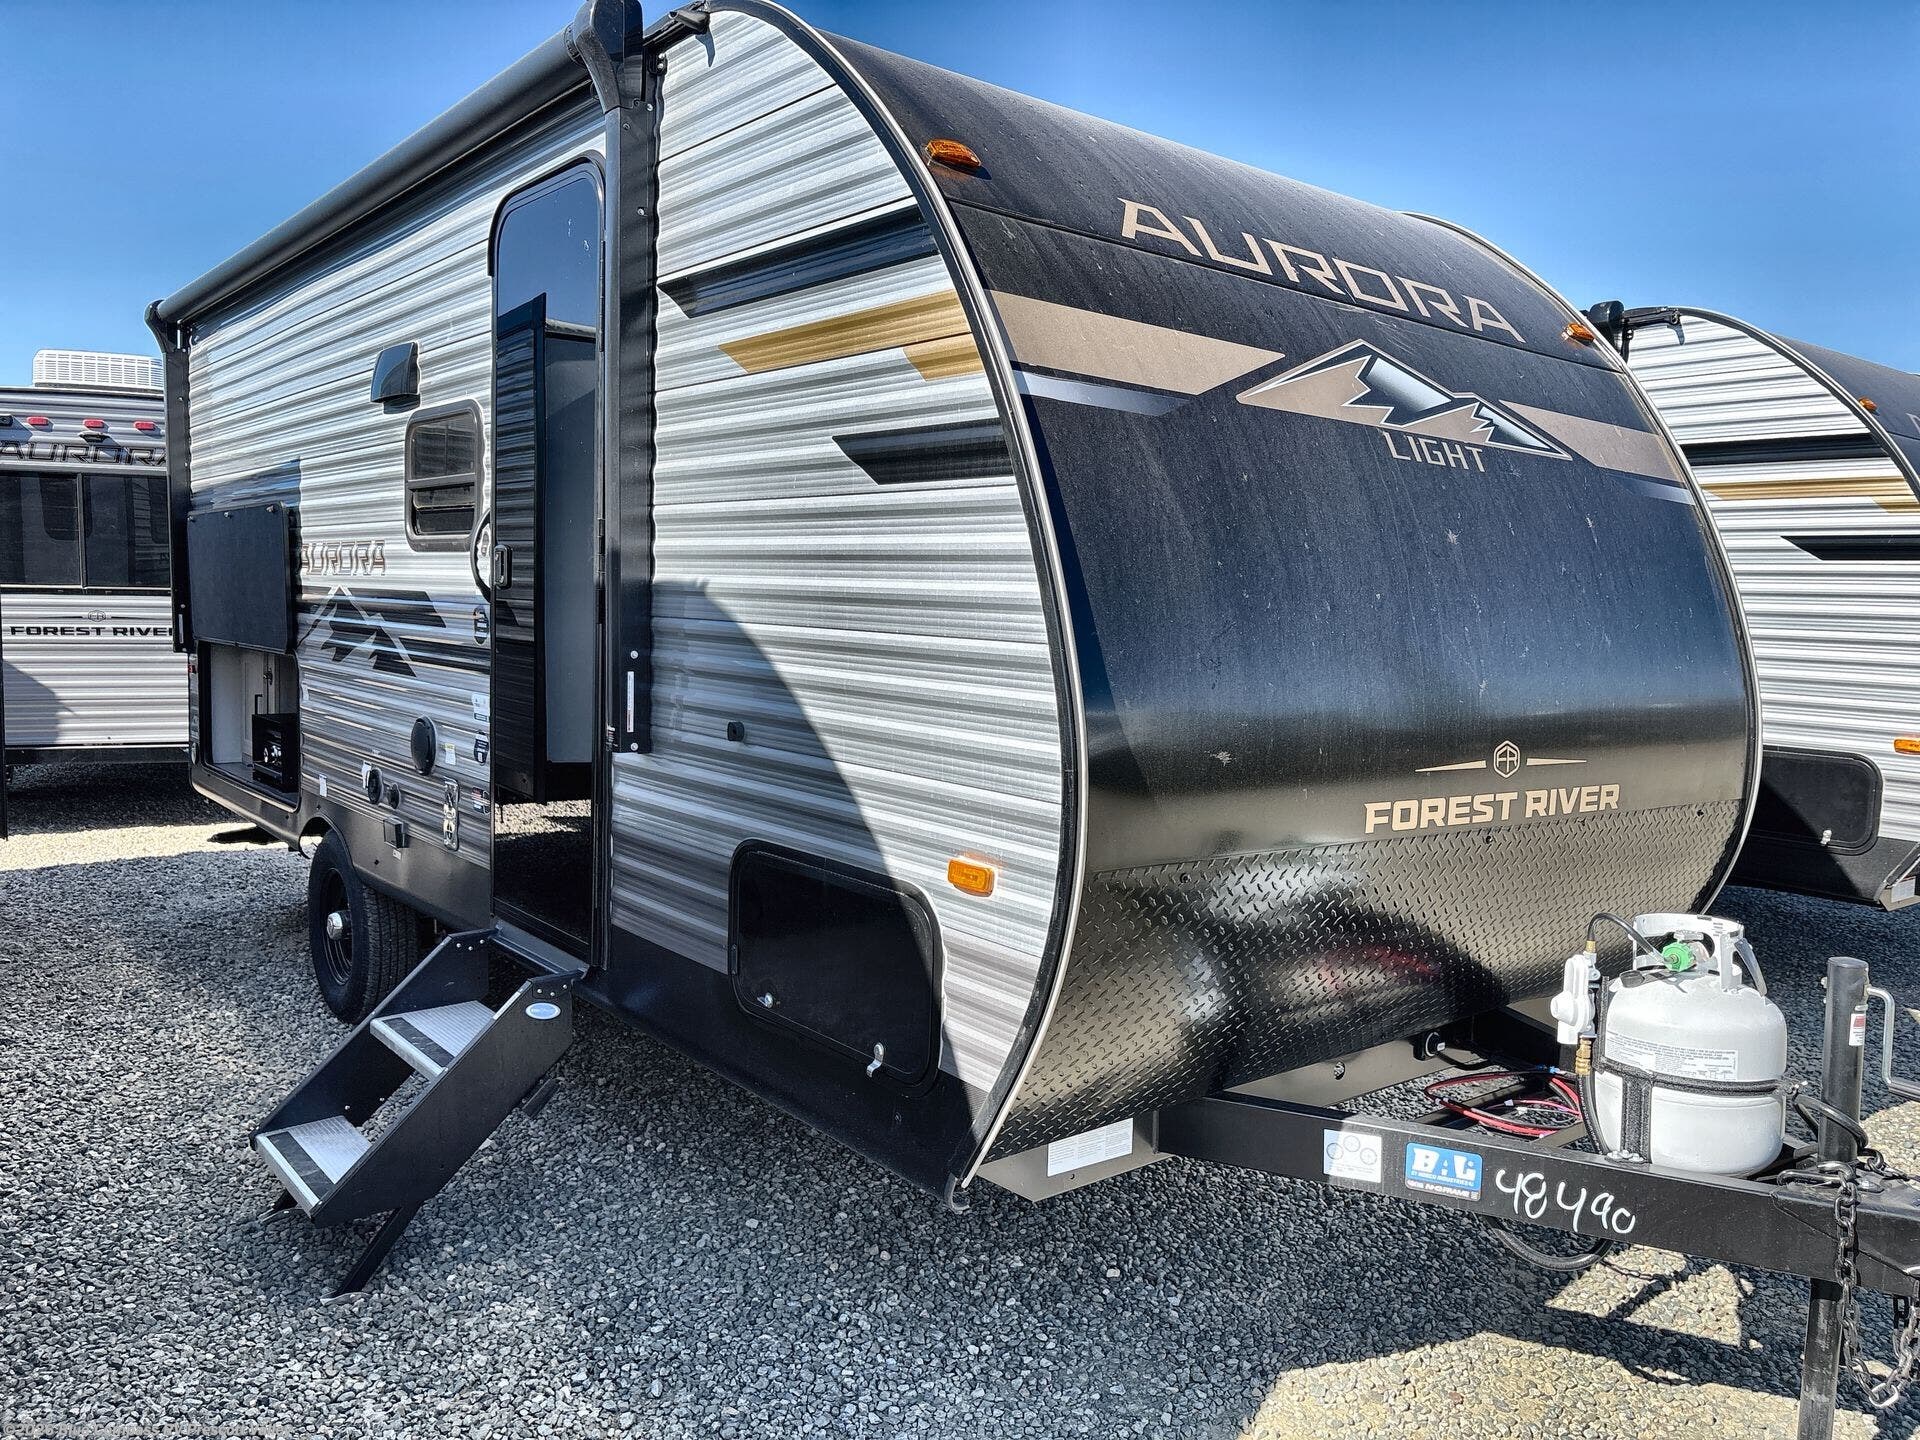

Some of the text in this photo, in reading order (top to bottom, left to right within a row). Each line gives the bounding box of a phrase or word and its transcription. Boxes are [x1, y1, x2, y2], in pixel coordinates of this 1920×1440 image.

[1117, 198, 1527, 343] AURORA
[1377, 428, 1485, 473] LIGHT
[10, 626, 106, 636] FOREST
[1364, 784, 1620, 834] FOREST RIVER
